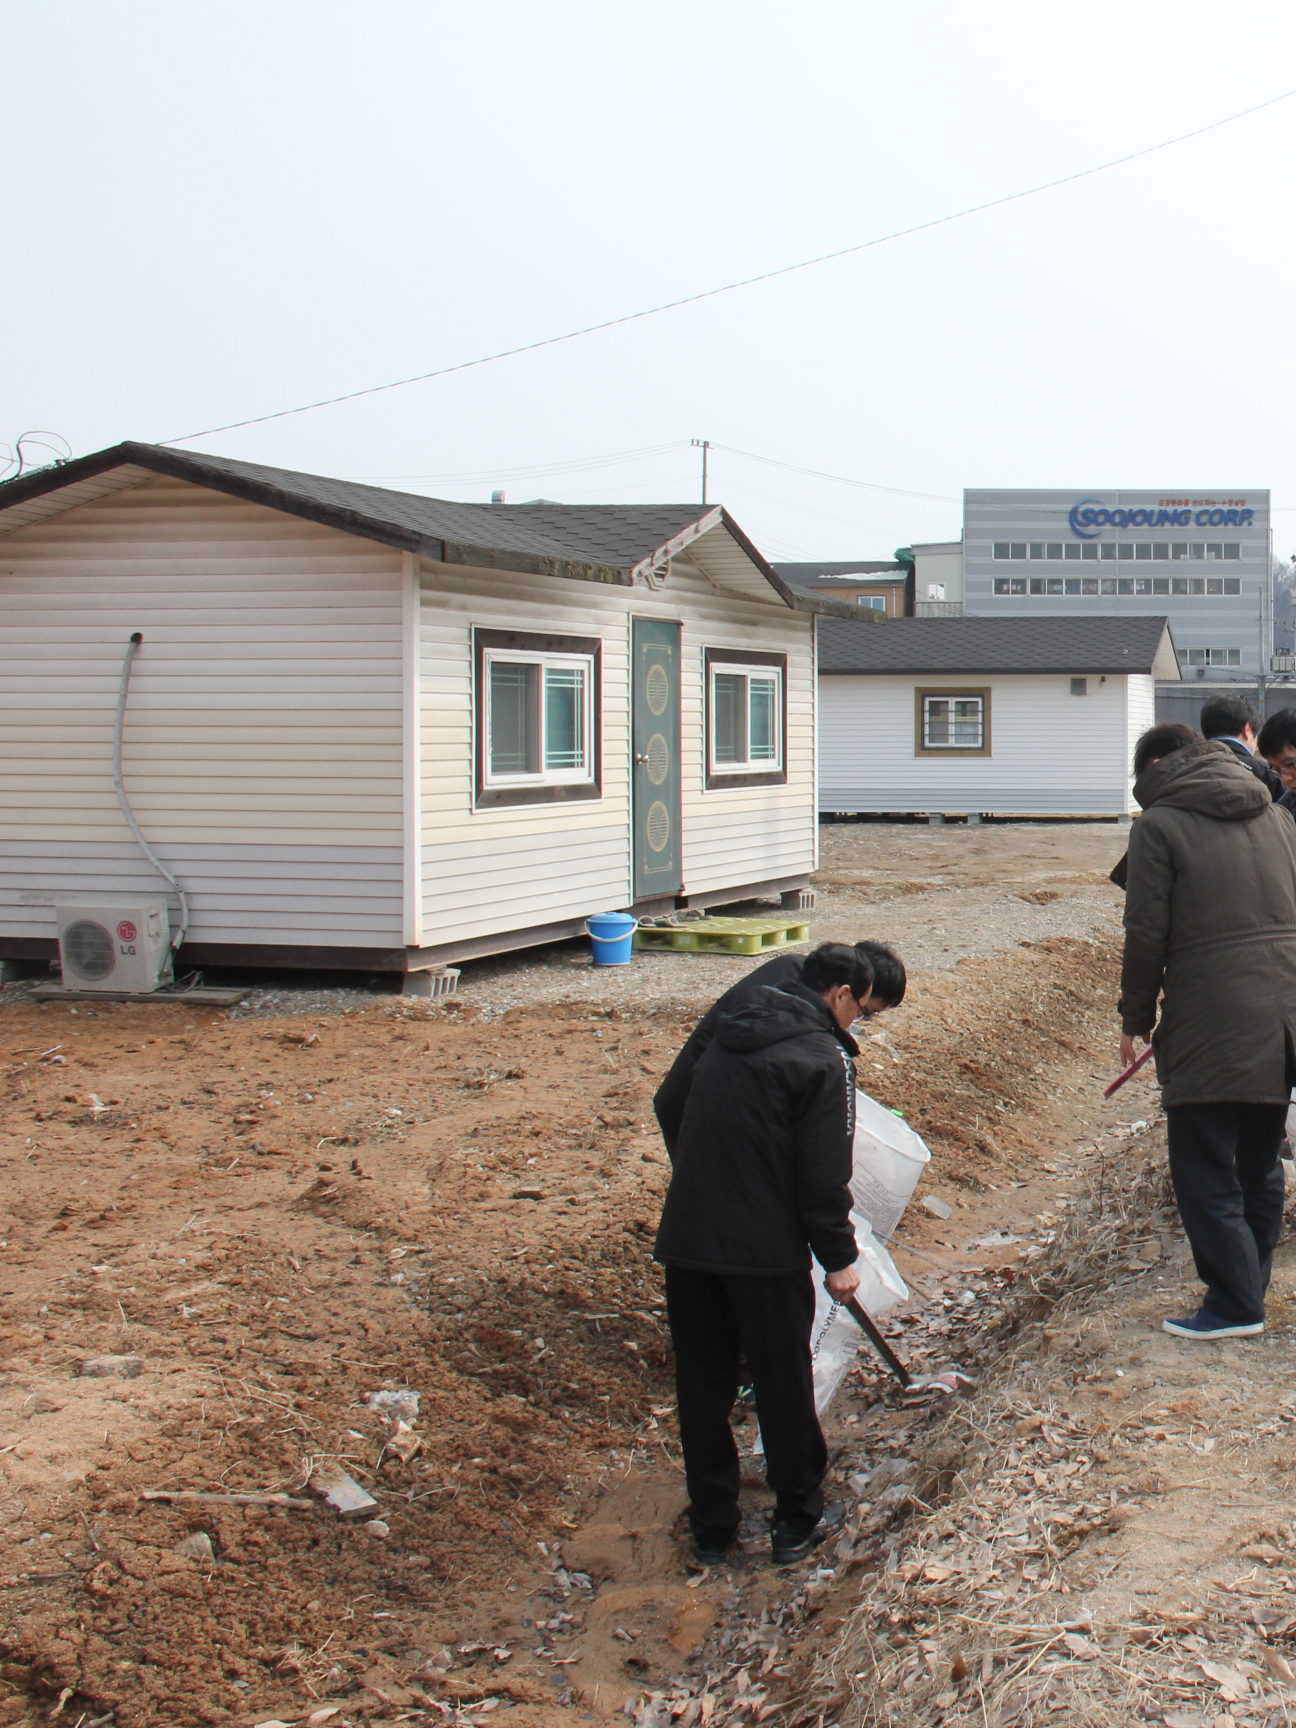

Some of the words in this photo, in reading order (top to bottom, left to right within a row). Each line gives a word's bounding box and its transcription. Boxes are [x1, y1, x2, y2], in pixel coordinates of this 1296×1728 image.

[1078, 508, 1191, 528] SOOJOUNG
[1195, 508, 1254, 527] CORP.
[120, 945, 137, 956] LG
